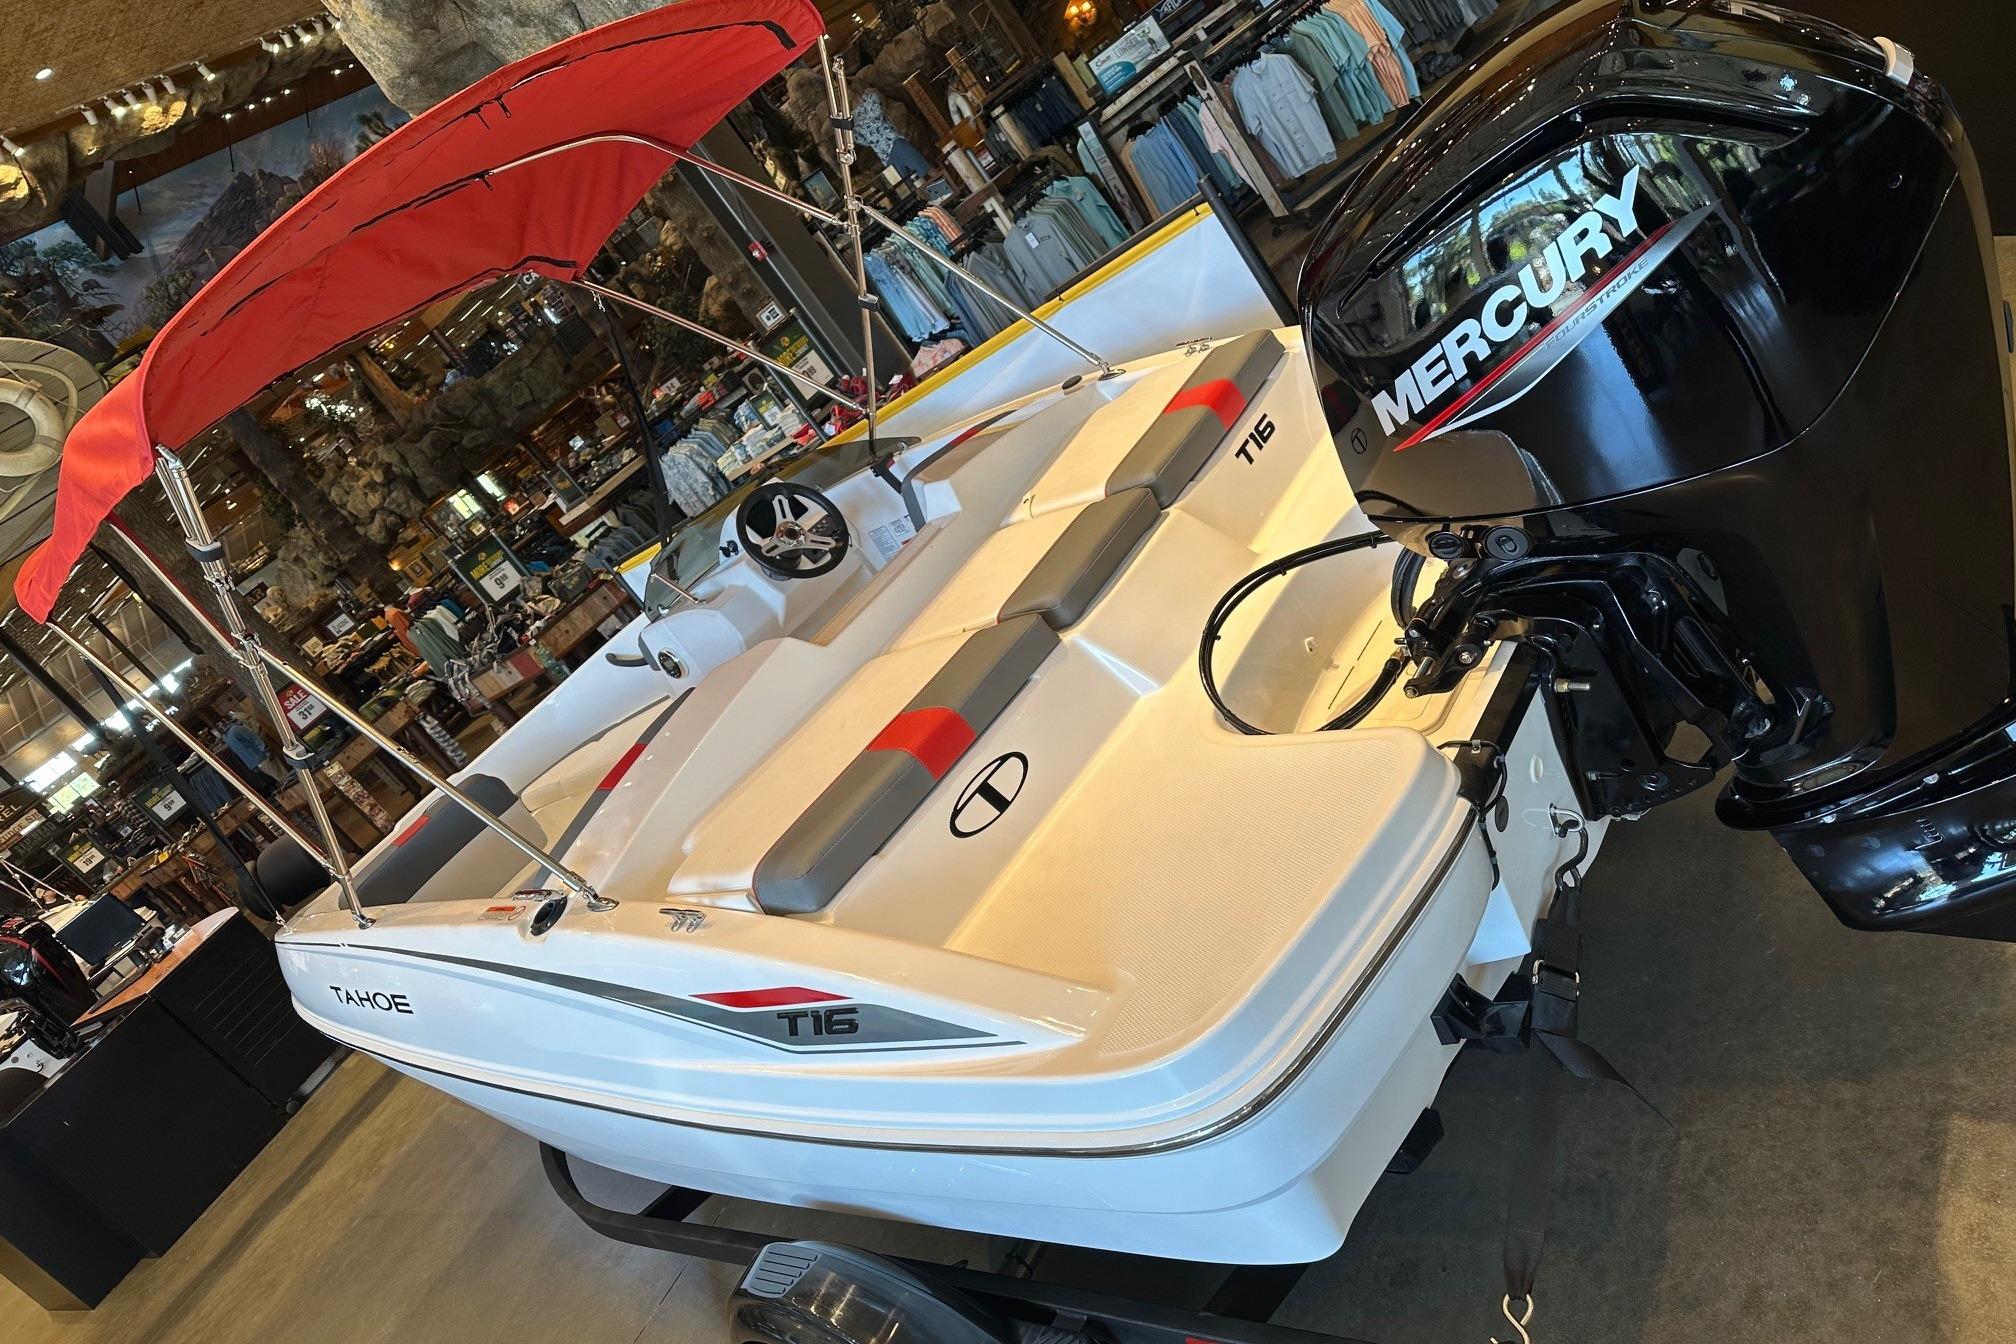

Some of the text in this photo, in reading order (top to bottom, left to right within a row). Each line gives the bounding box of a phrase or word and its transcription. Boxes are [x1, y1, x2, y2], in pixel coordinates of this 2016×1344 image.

[1371, 164, 1640, 437] MERCURY
[1543, 257, 1649, 351] FOURSTROKE
[1234, 412, 1276, 466] T16
[284, 689, 308, 710] SALE
[329, 985, 414, 1014] TAHOE
[777, 1007, 859, 1036] T16
